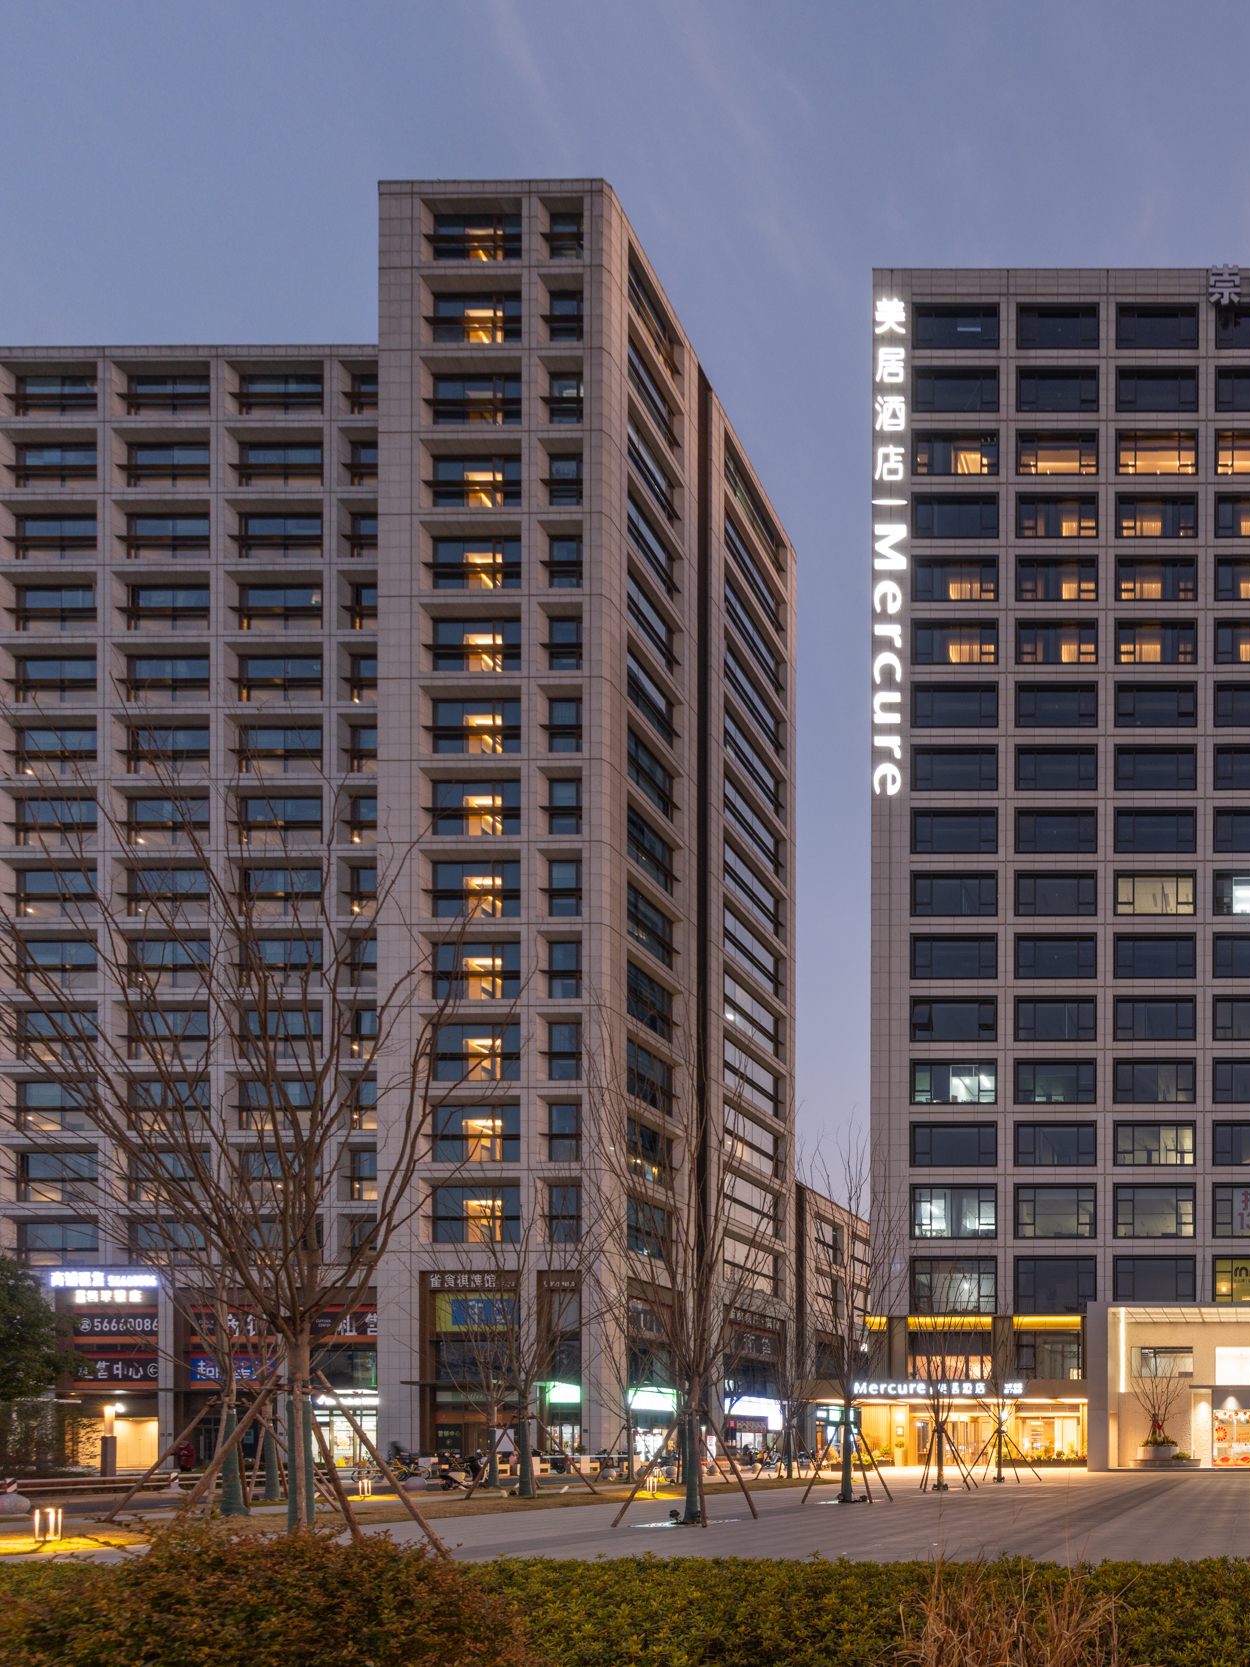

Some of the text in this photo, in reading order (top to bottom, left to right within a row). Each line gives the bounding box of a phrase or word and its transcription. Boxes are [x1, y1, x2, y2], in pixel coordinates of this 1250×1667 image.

[874, 297, 906, 482] 美居酒店
[873, 523, 907, 797] Mercure
[853, 1382, 926, 1395] Mercure
